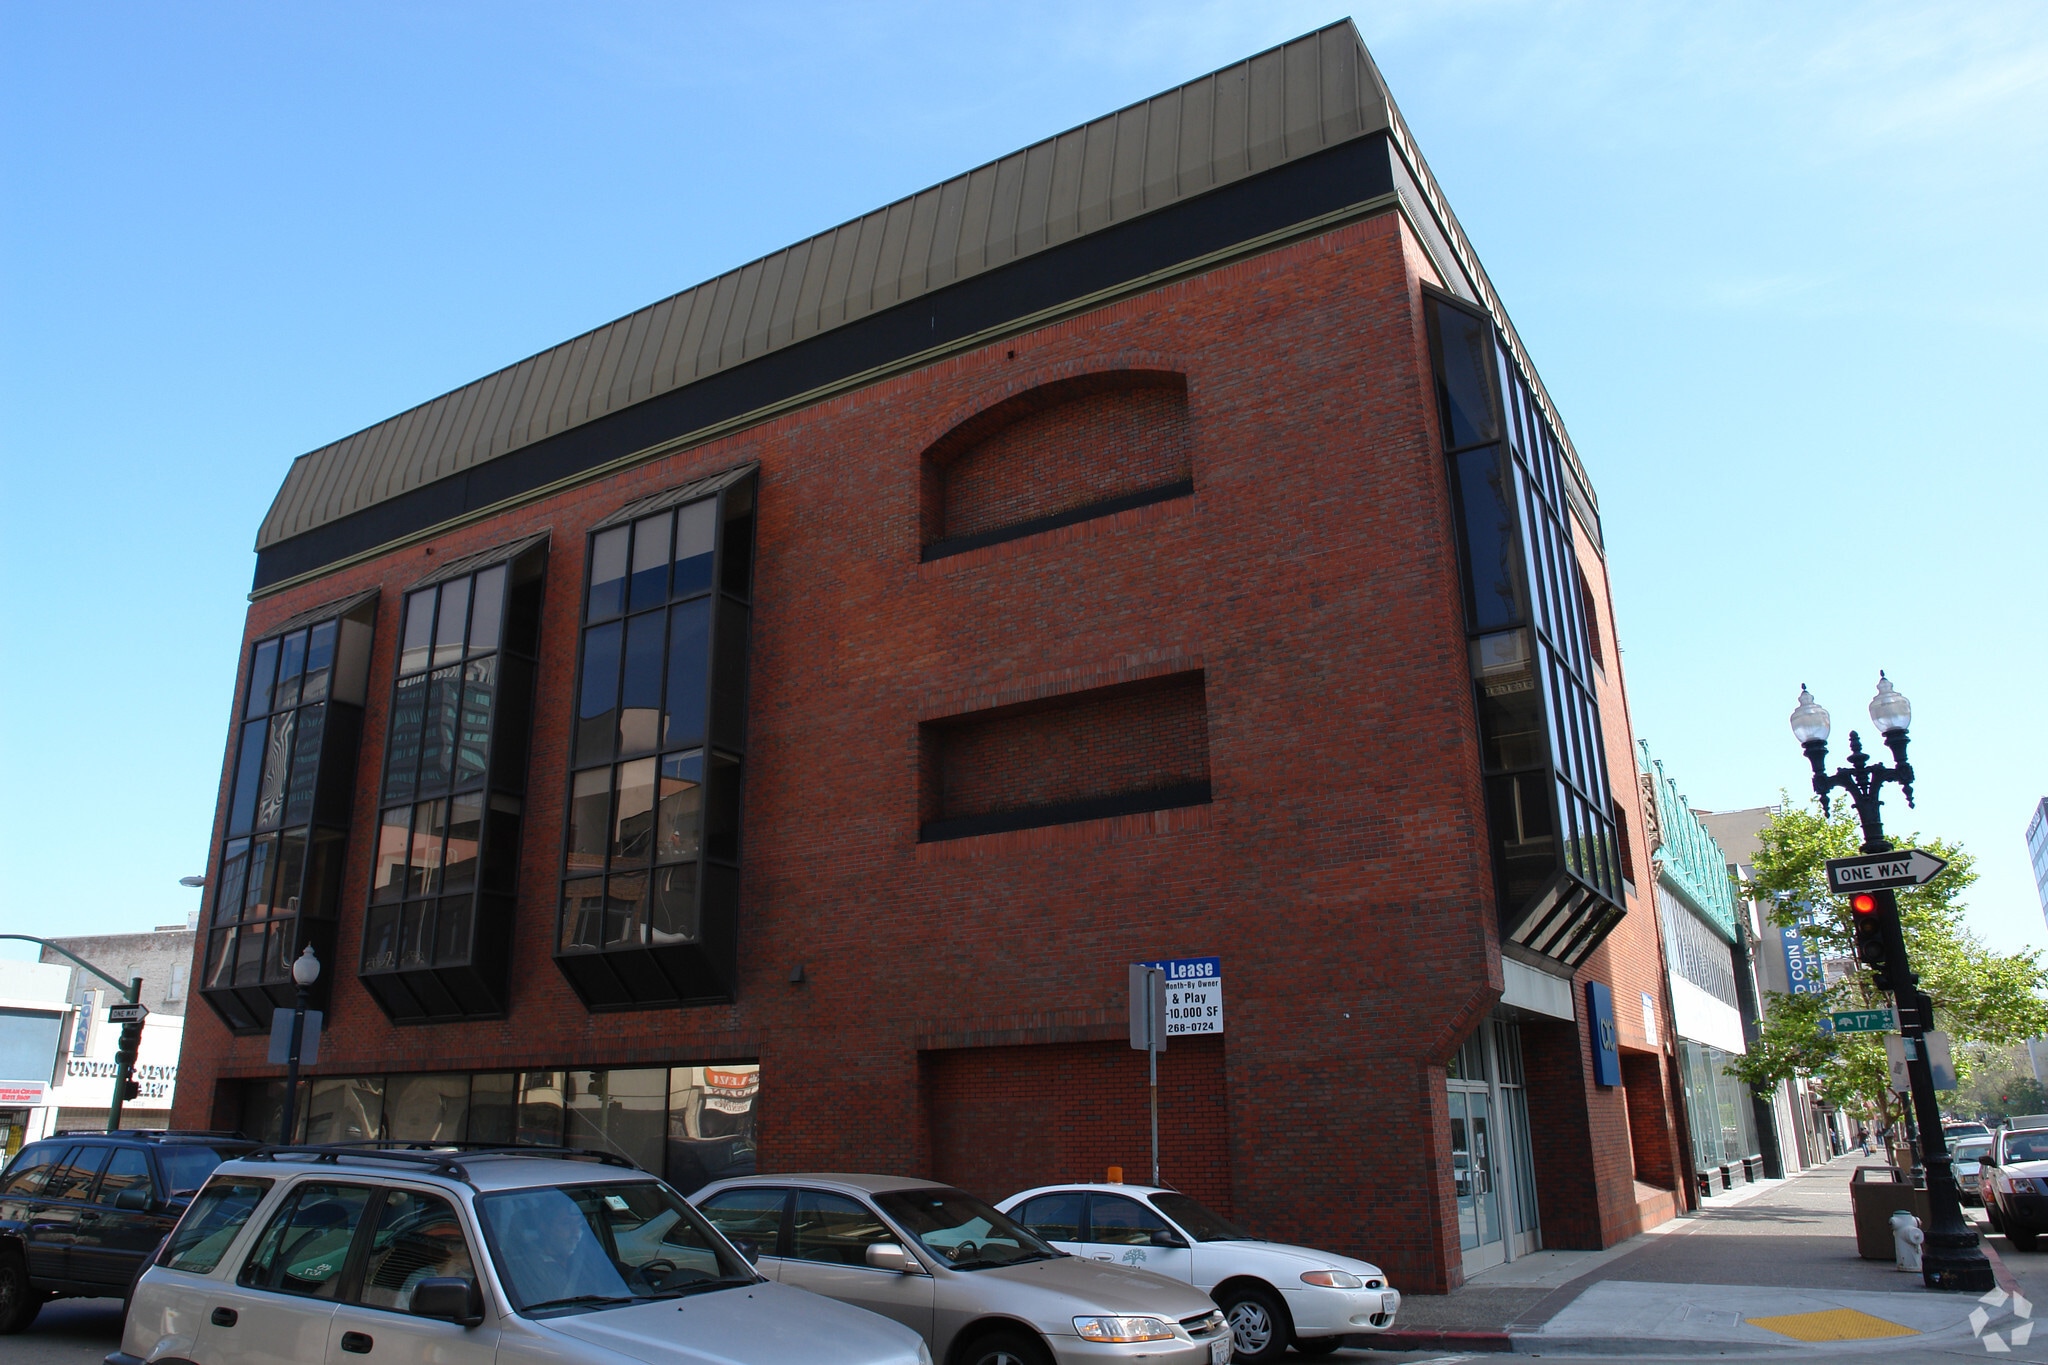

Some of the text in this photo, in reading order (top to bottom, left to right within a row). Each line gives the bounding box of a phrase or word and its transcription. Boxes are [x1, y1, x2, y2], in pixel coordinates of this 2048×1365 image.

[1840, 862, 1910, 882] ONE WAY
[1785, 928, 1797, 939] &
[1787, 944, 1805, 981] COIN
[1170, 962, 1213, 979] Lease
[1197, 980, 1219, 988] Owner
[1172, 992, 1207, 1005] & Play
[113, 1010, 125, 1018] ONE
[1206, 1006, 1219, 1017] SF
[1167, 1022, 1214, 1033] 268-0724
